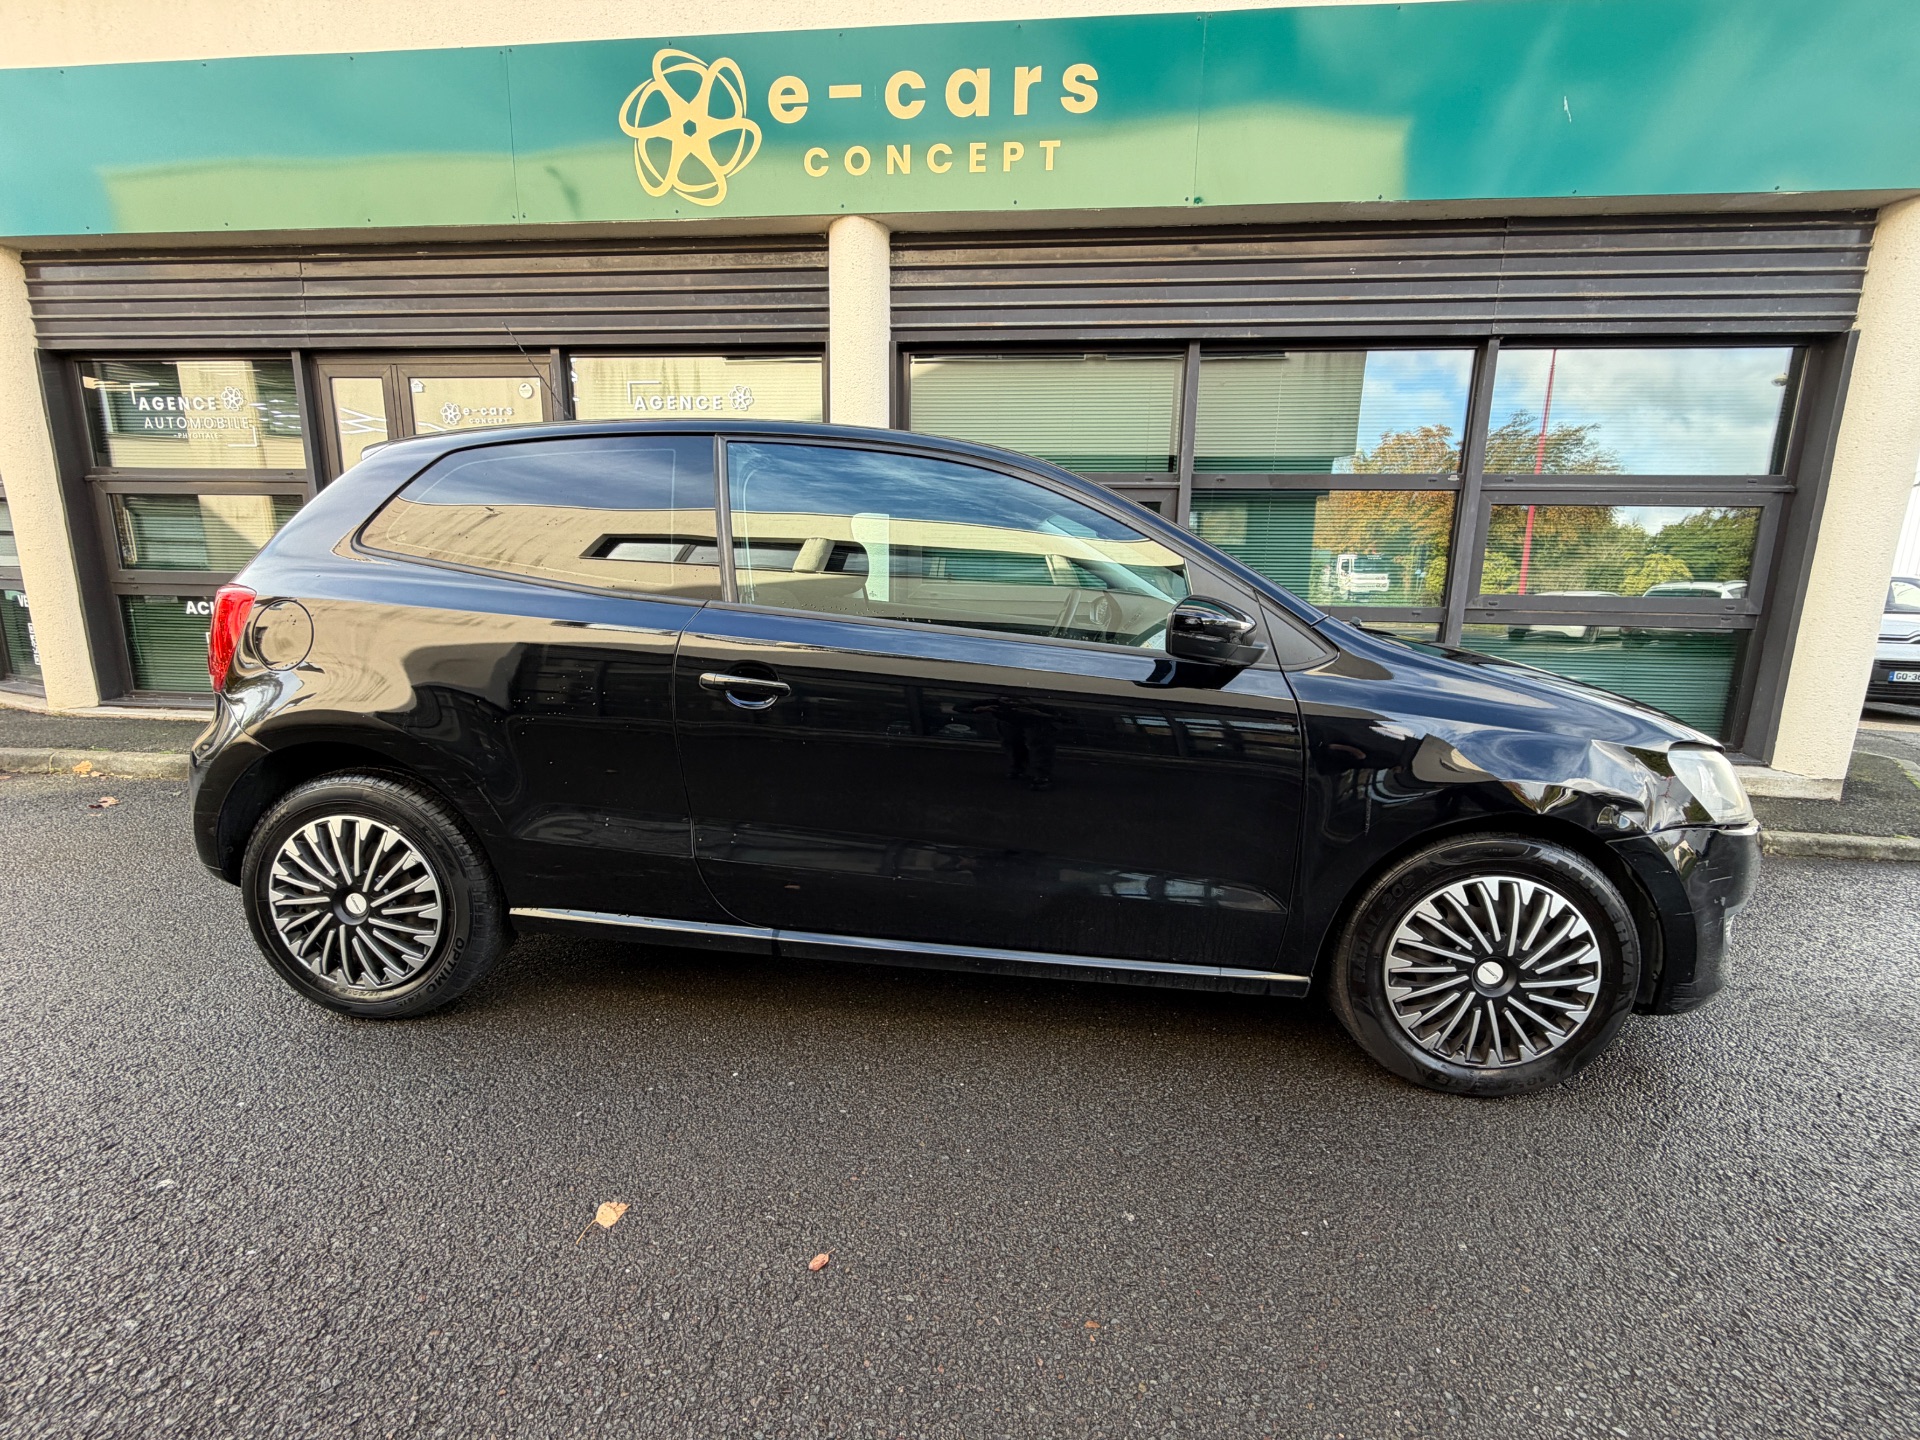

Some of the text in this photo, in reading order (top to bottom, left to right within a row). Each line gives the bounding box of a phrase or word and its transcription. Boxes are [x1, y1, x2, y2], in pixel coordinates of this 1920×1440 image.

[803, 140, 1061, 177] CONCEPT
[138, 396, 217, 411] AGENCE
[633, 395, 723, 411] AGENCE
[462, 406, 514, 416] e-cars
[144, 416, 250, 430] AUTOMOBILE
[425, 936, 465, 994] OPTIMO
